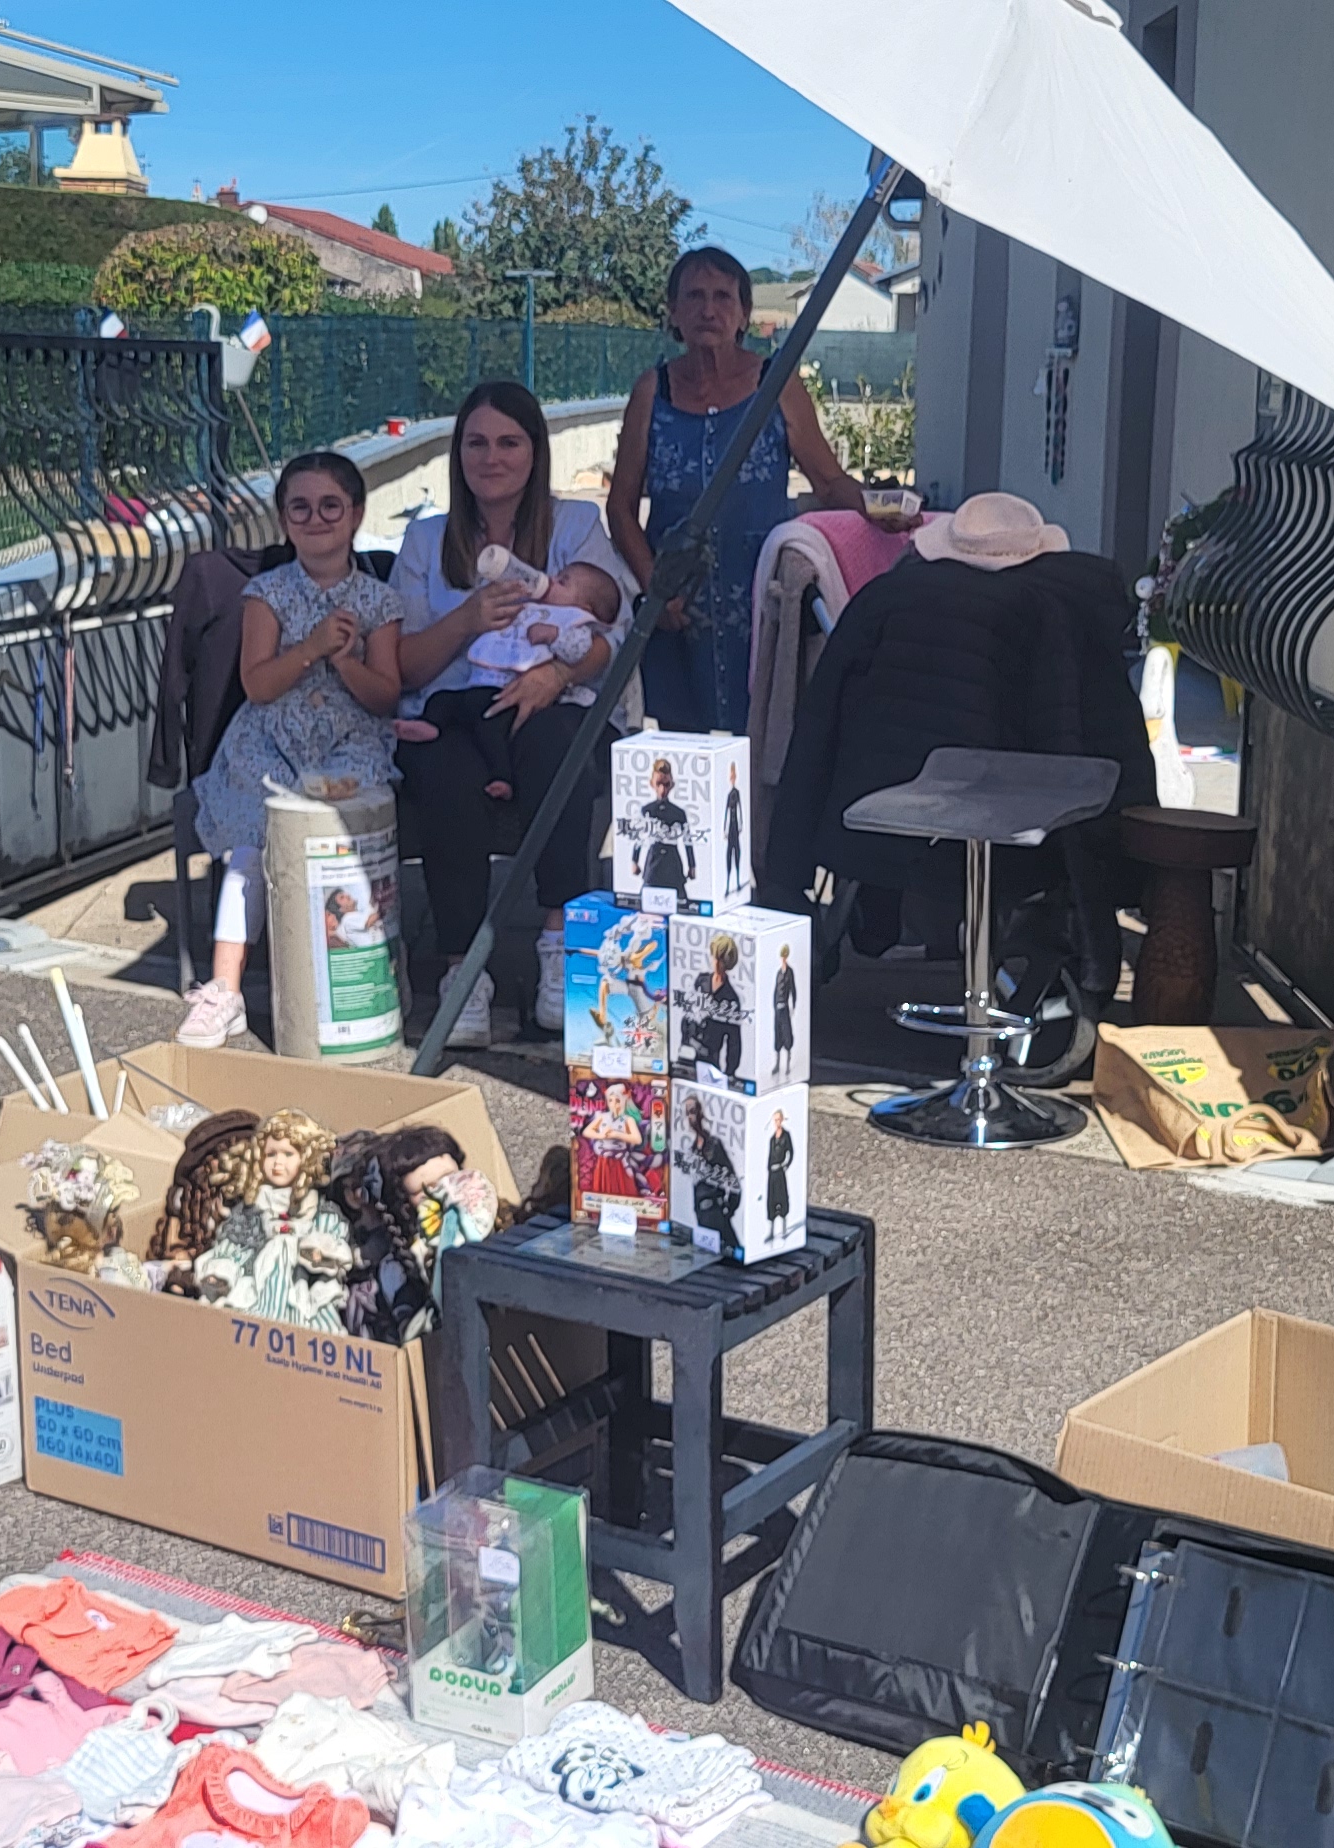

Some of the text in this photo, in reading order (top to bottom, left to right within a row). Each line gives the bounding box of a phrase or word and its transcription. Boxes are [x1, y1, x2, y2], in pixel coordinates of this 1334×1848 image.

[616, 774, 712, 802] REEN
[45, 1289, 96, 1319] TENA
[30, 1331, 72, 1364] Bed
[231, 1318, 382, 1378] 77 01 19 NL
[33, 1361, 85, 1386] Underpad
[35, 1396, 75, 1419] PLUS
[37, 1415, 57, 1433] 60
[73, 1425, 94, 1443] 60
[97, 1434, 122, 1452] cm
[37, 1434, 66, 1454] 160
